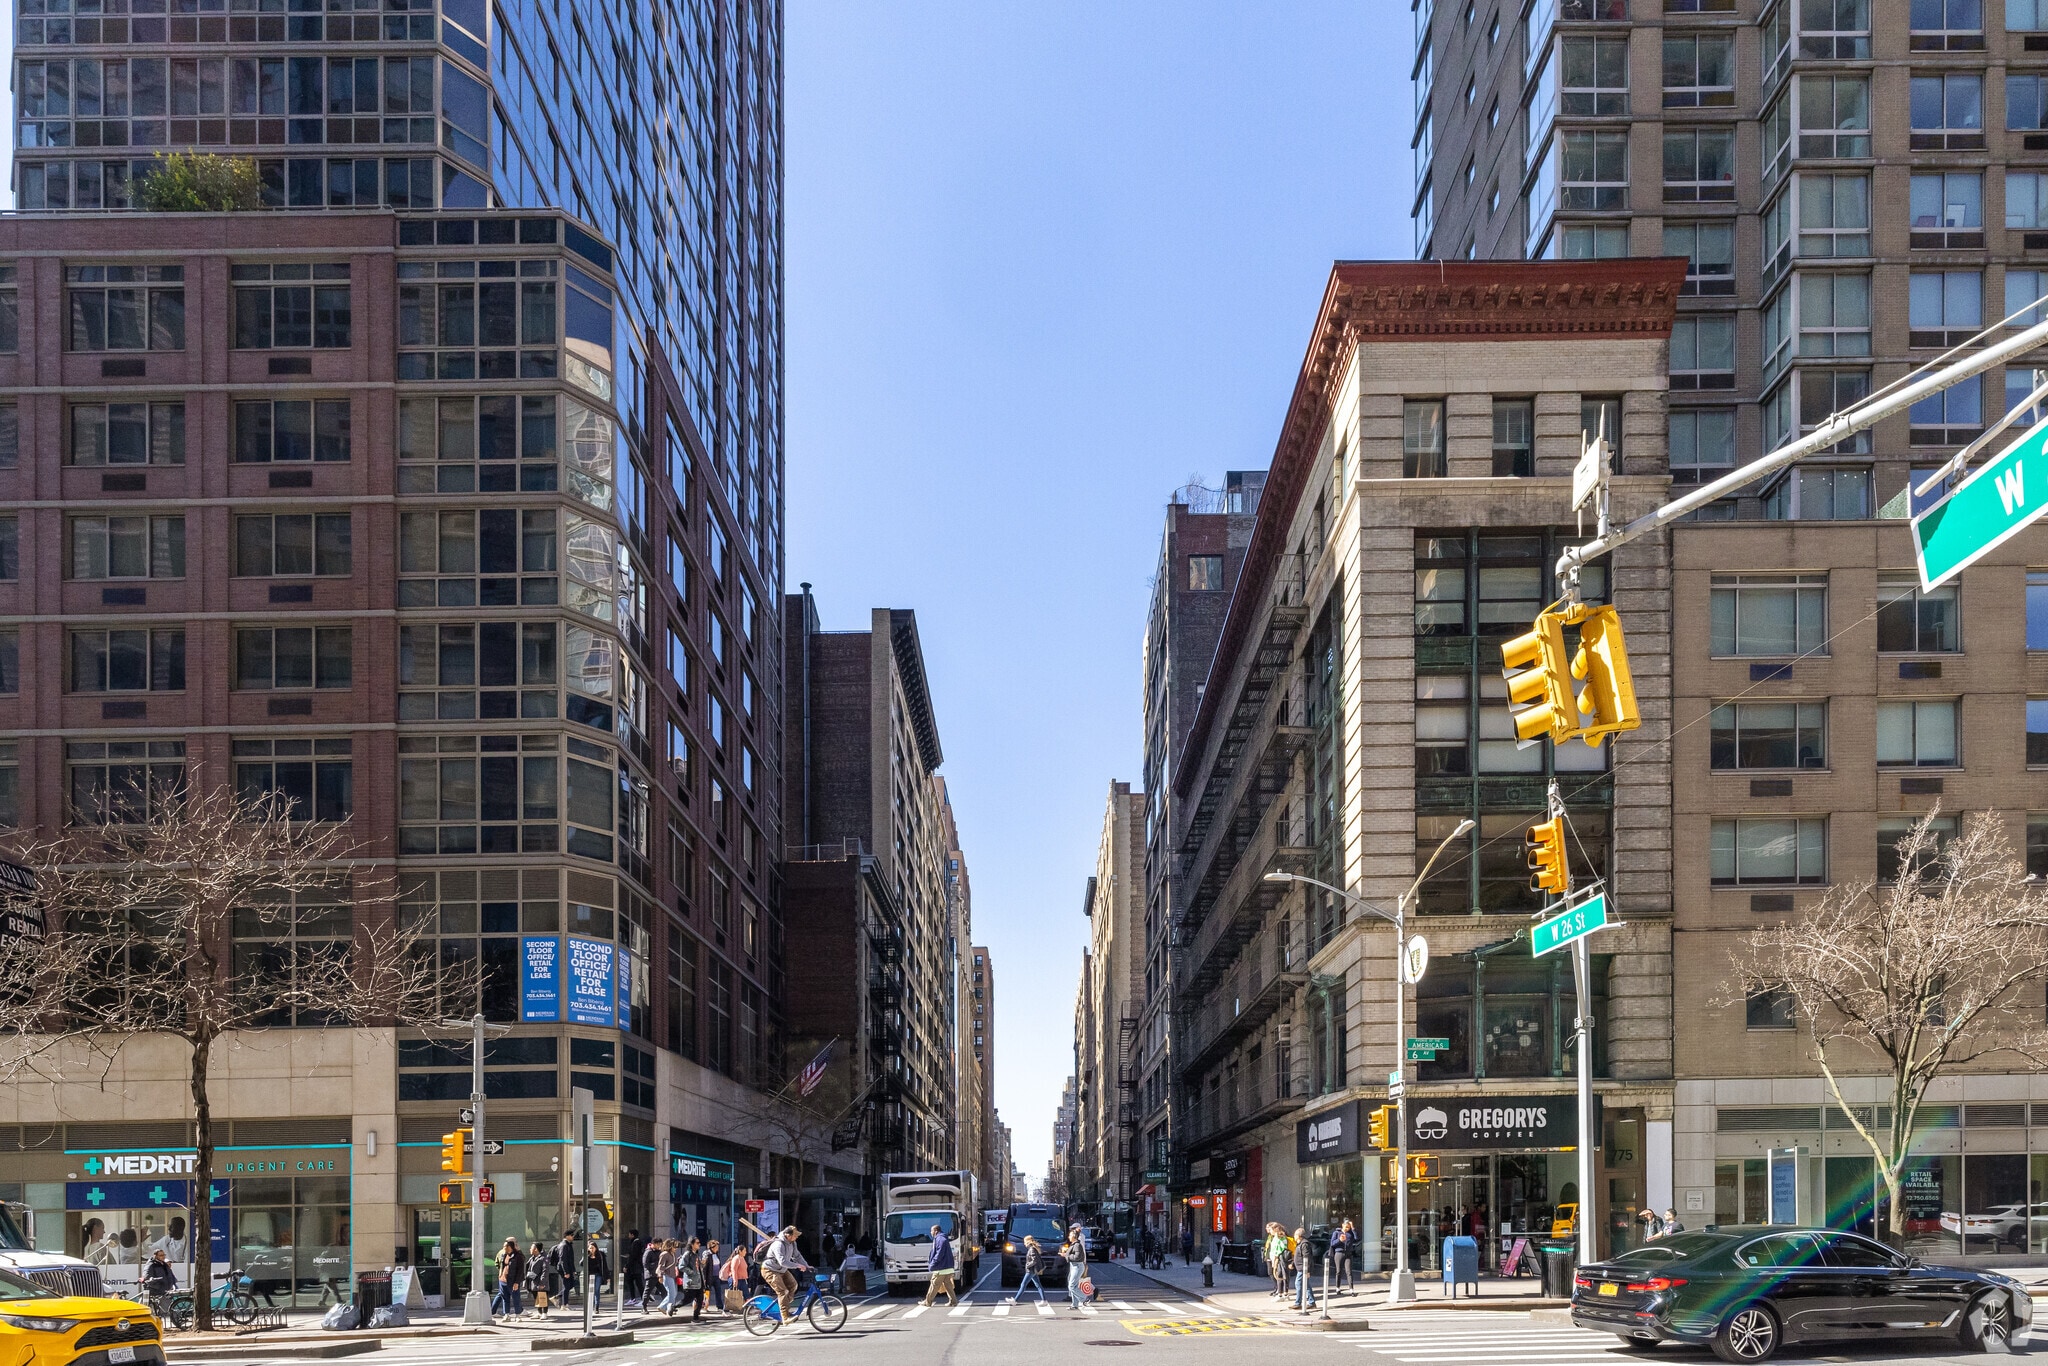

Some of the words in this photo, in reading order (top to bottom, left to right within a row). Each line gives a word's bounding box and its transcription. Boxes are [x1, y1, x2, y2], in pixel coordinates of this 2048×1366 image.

[1994, 458, 2025, 517] W
[1551, 923, 1558, 942] W
[1561, 917, 1573, 938] 26
[1575, 911, 1586, 931] St
[570, 940, 612, 955] SECOND
[573, 949, 608, 963] FLOOR
[570, 958, 611, 973] OFFICE/
[574, 967, 608, 980] RETAIL
[580, 977, 602, 988] FOR
[575, 984, 607, 997] LEASE
[570, 1001, 612, 1012] 703.434.1461
[1412, 1050, 1418, 1059] 6
[1458, 1107, 1547, 1129] GREGORYS
[1472, 1130, 1534, 1139] COFFEE
[104, 1155, 198, 1175] MEDRIT
[225, 1161, 287, 1173] URGENT
[296, 1160, 335, 1171] CARE
[678, 1158, 706, 1177] MEDRITE
